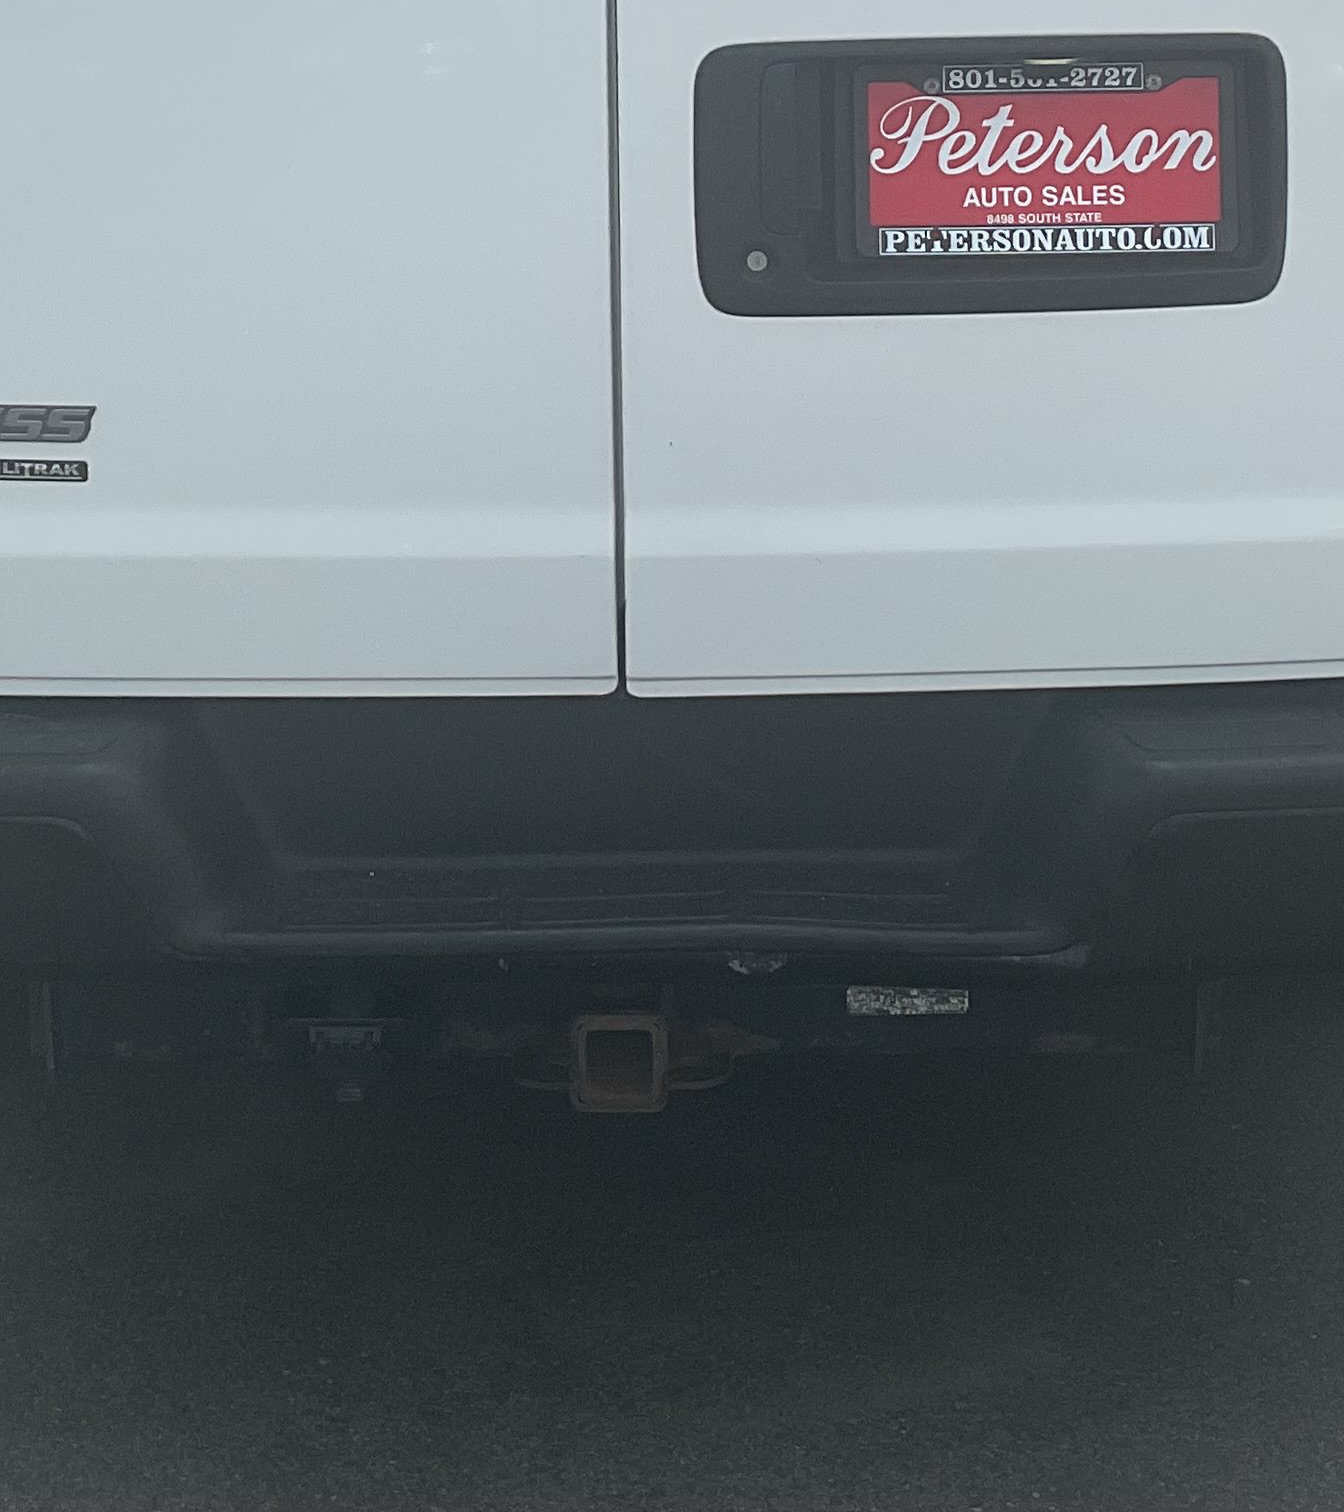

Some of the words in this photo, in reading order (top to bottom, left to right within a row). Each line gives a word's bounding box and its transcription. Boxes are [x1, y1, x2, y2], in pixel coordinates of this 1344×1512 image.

[869, 95, 1217, 176] Peterson
[962, 186, 1034, 208] AUTO
[1041, 184, 1126, 206] SALES
[1018, 213, 1062, 224] SOUTH
[1065, 212, 1103, 223] STATE
